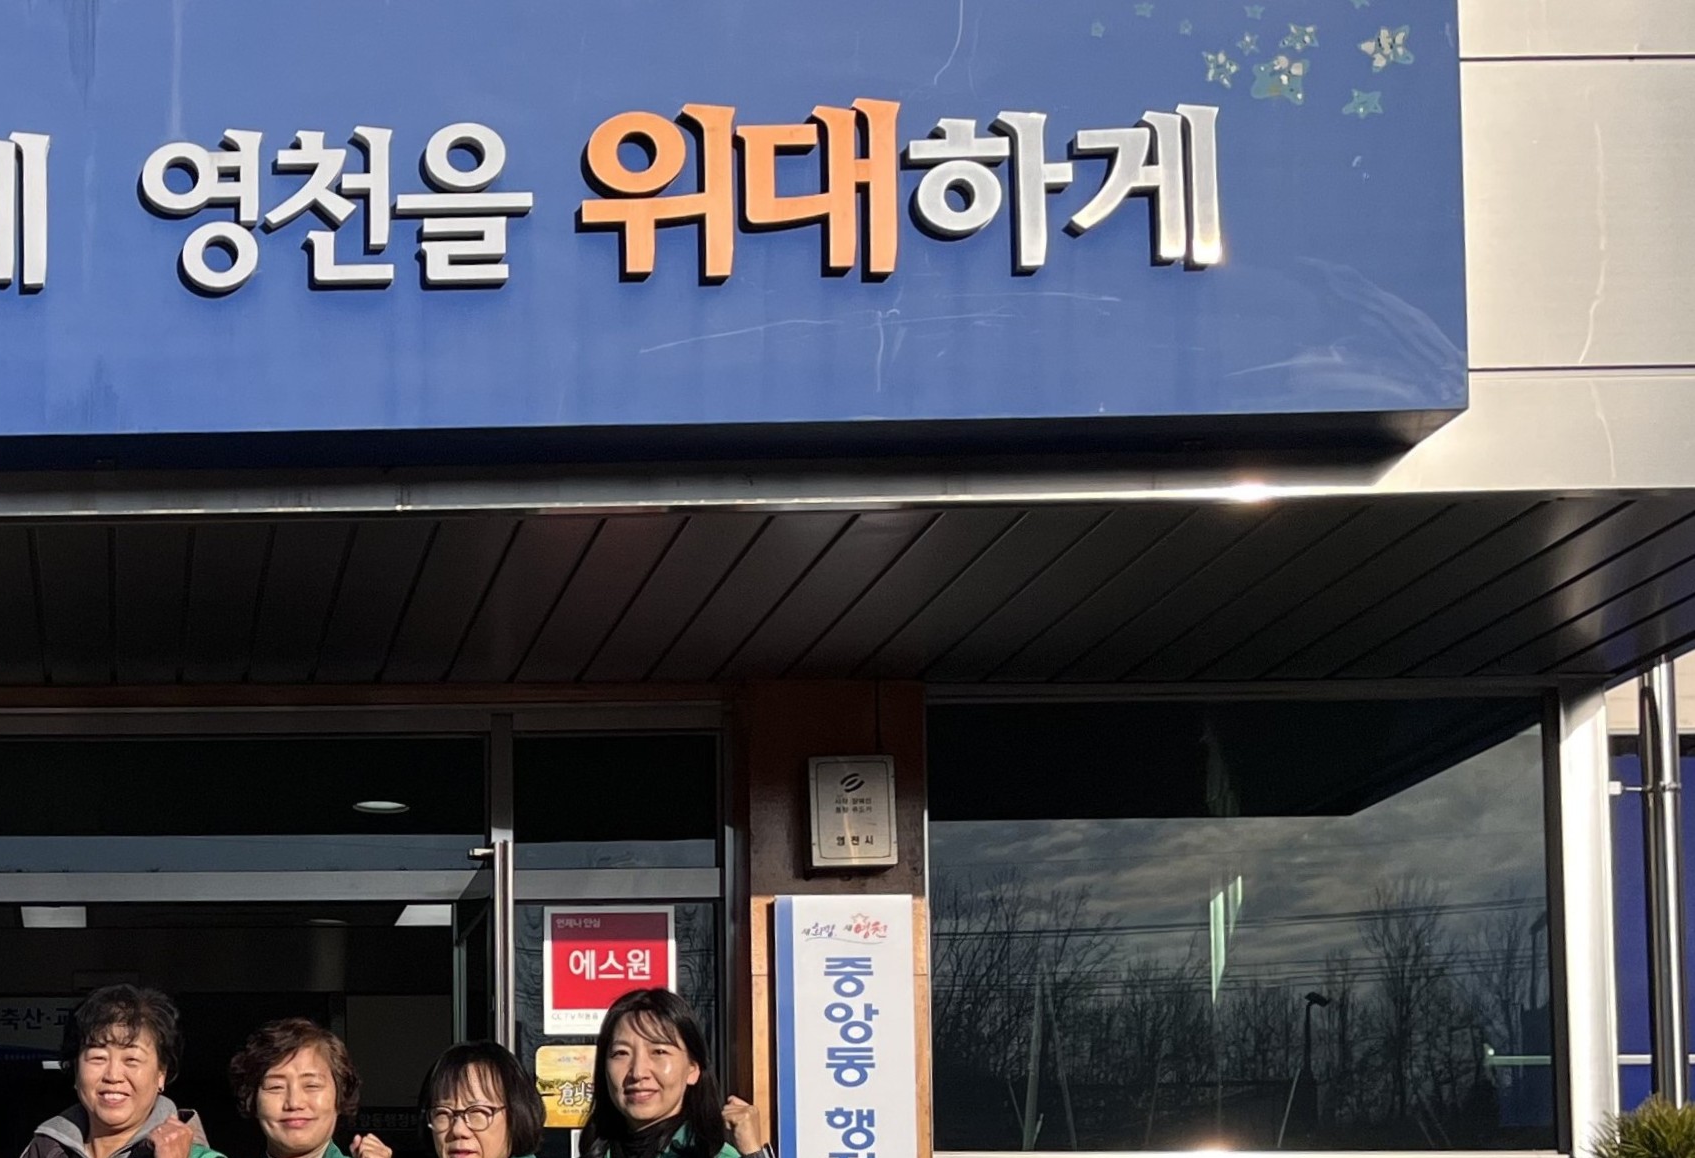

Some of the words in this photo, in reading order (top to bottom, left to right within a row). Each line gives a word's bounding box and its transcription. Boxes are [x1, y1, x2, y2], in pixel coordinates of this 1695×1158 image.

[142, 122, 533, 289] 영천을
[578, 99, 1222, 280] 위대하게
[837, 836, 873, 846] 영천시
[556, 919, 582, 928] 언제나
[583, 919, 600, 928] 안심
[569, 949, 651, 980] 에스원
[823, 956, 879, 1088] 중앙동
